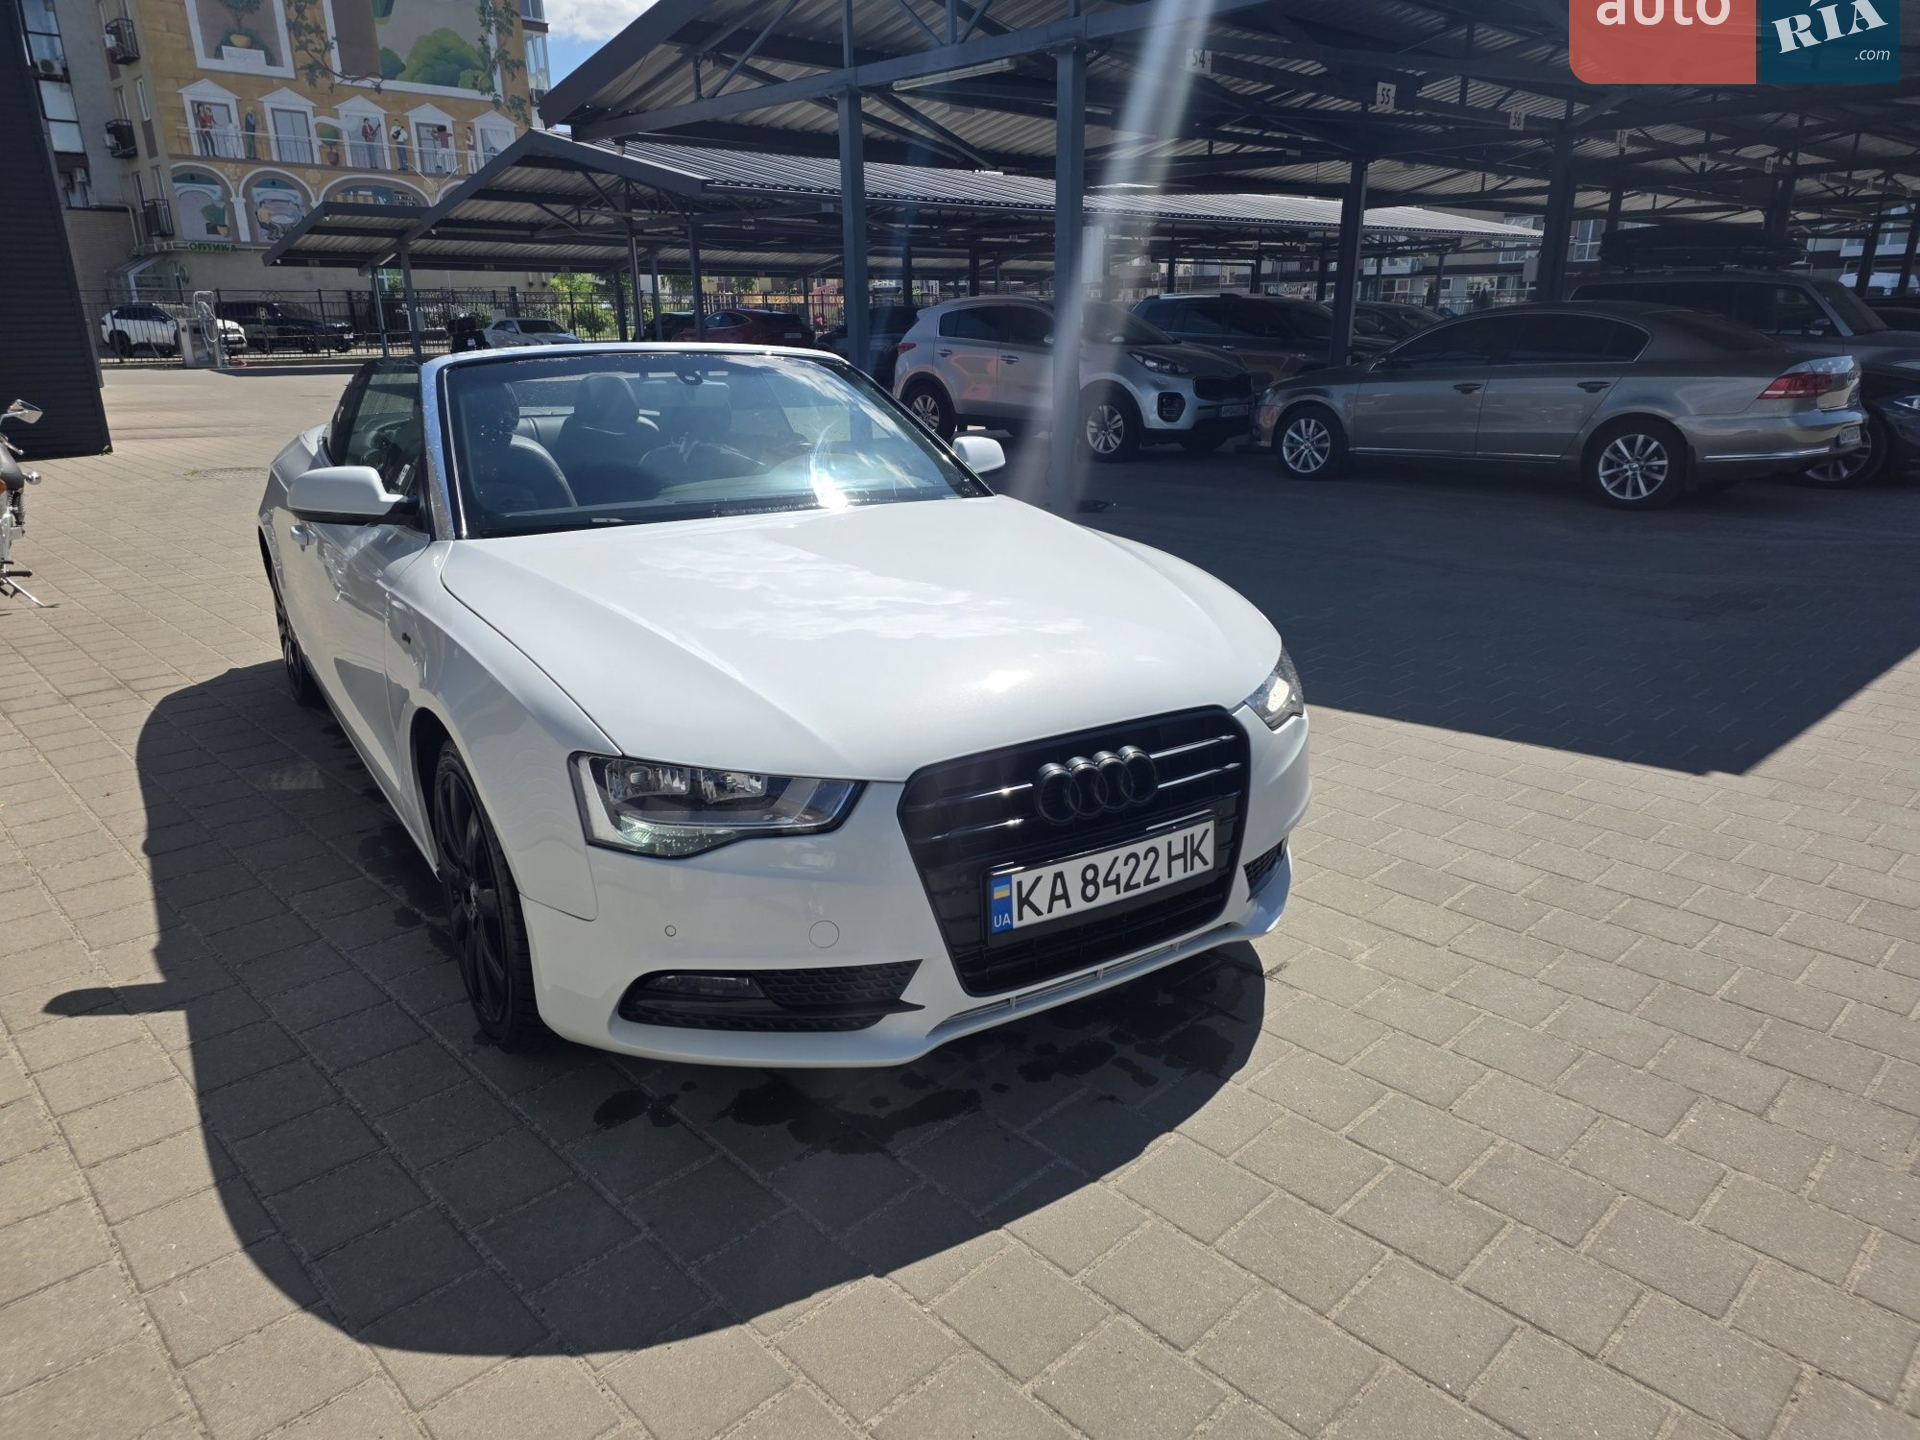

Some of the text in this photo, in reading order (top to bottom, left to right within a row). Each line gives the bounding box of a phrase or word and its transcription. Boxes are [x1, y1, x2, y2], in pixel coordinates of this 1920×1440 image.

[1380, 87, 1391, 106] 55
[1512, 111, 1522, 127] 56
[1016, 828, 1210, 922] KA 8422 HK
[993, 913, 1011, 928] UA
